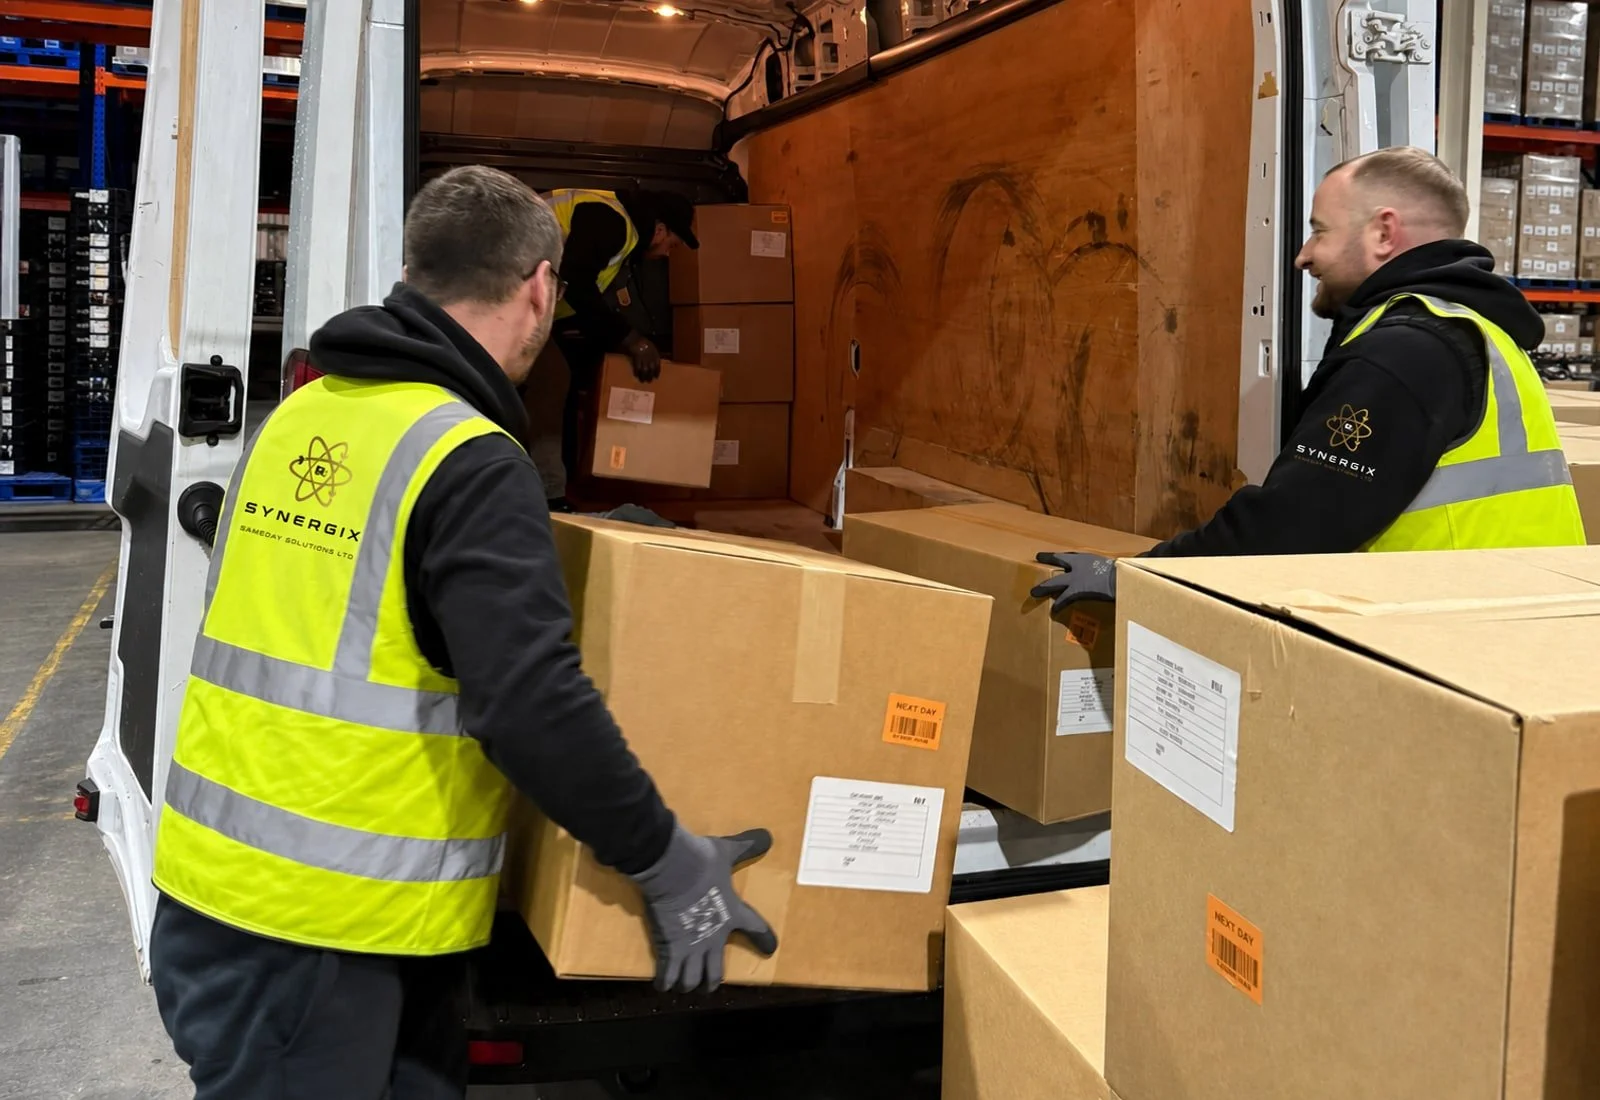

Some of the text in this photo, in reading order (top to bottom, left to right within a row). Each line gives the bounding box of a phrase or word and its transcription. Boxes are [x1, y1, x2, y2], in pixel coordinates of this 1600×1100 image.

[1296, 444, 1376, 477] SYNERGIX
[244, 501, 361, 542] SYNERGIX
[240, 525, 354, 560] SAMEDAY SOLUTIONS LTD
[896, 702, 937, 716] NEXT DAY
[1214, 910, 1254, 946] NEXT DAY
